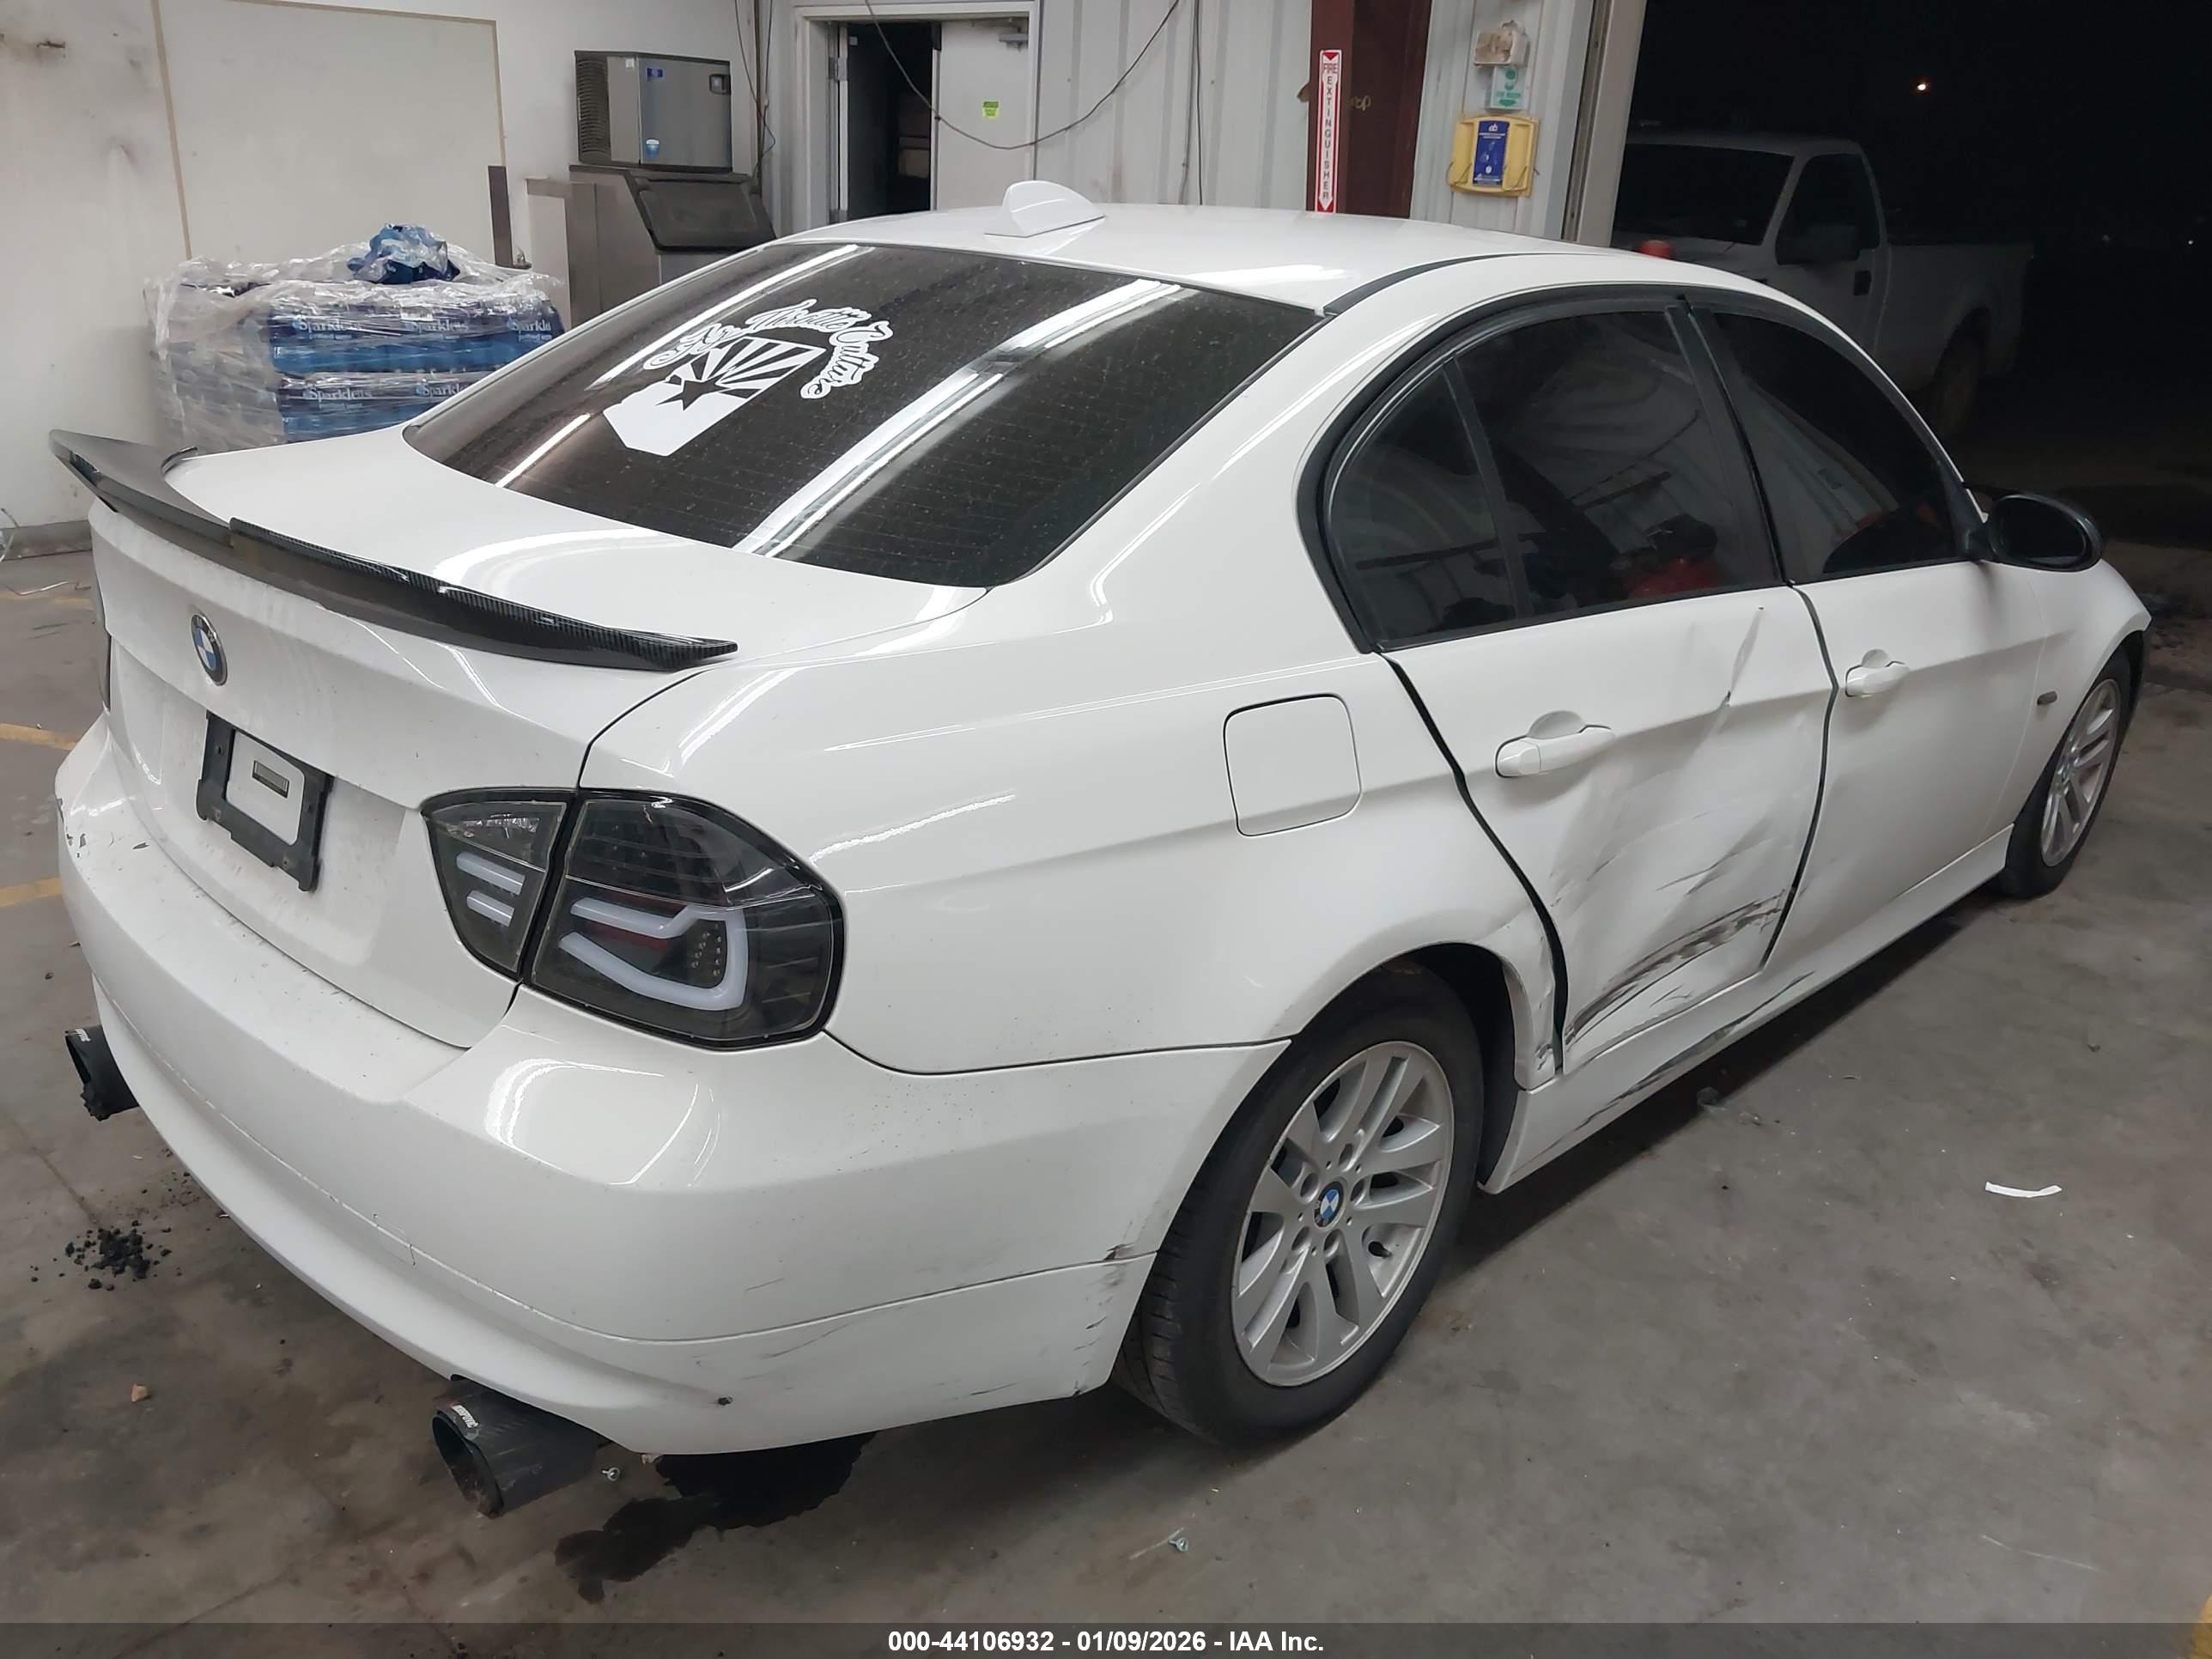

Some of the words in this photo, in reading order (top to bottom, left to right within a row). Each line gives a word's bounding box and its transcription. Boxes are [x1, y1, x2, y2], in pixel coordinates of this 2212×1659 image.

[1323, 63, 1339, 74] FIRE
[1322, 76, 1333, 199] EXTINGUISHER
[744, 298, 872, 336] Throttle
[800, 320, 893, 399] Culture
